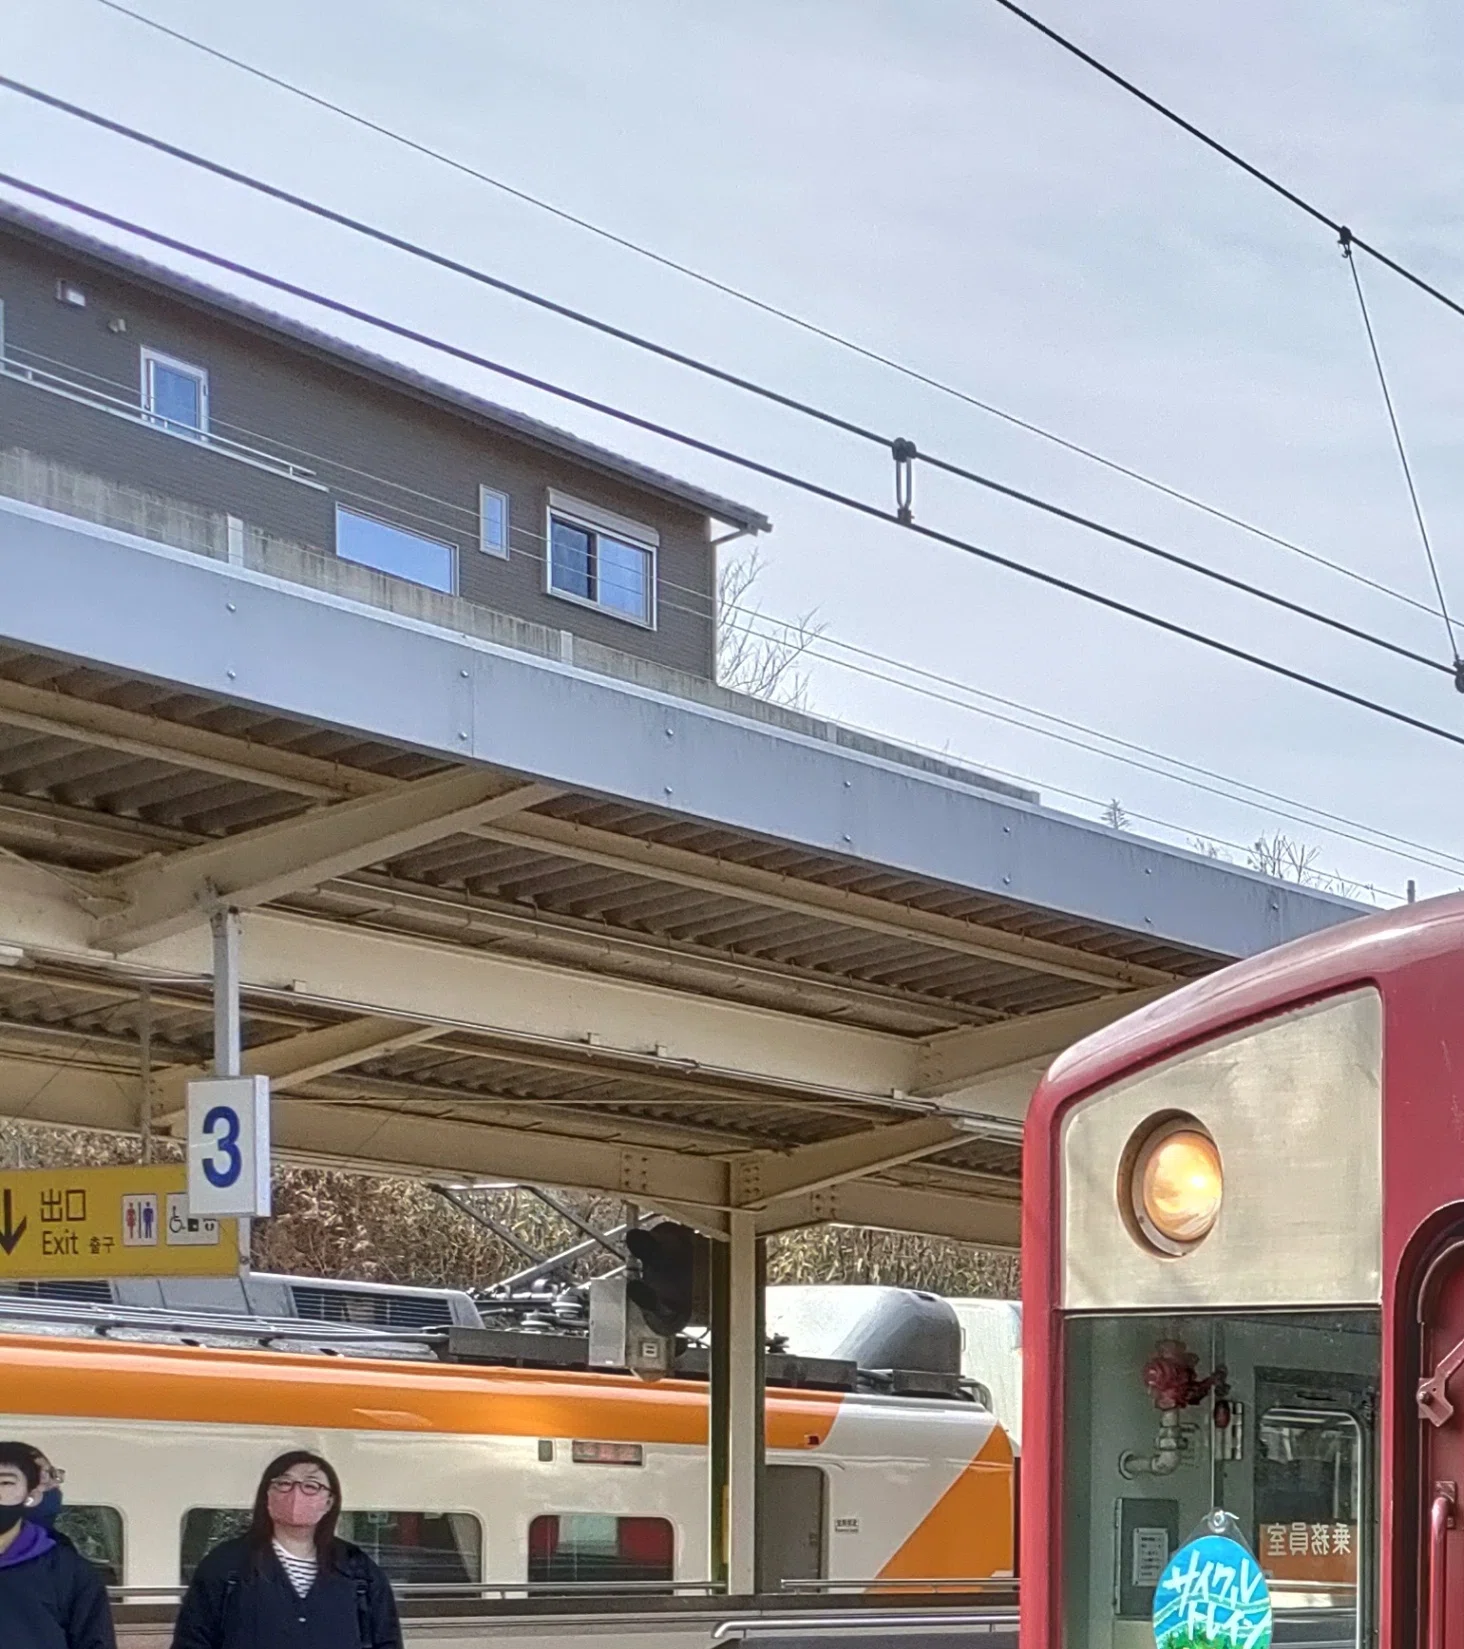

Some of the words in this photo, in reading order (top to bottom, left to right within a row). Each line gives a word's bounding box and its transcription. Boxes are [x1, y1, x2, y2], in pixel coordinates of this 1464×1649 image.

[202, 1106, 242, 1188] 3
[41, 1188, 86, 1222] 出口
[42, 1229, 79, 1255] Exit
[89, 1236, 115, 1254] 출구
[1163, 1550, 1263, 1617] サイクル
